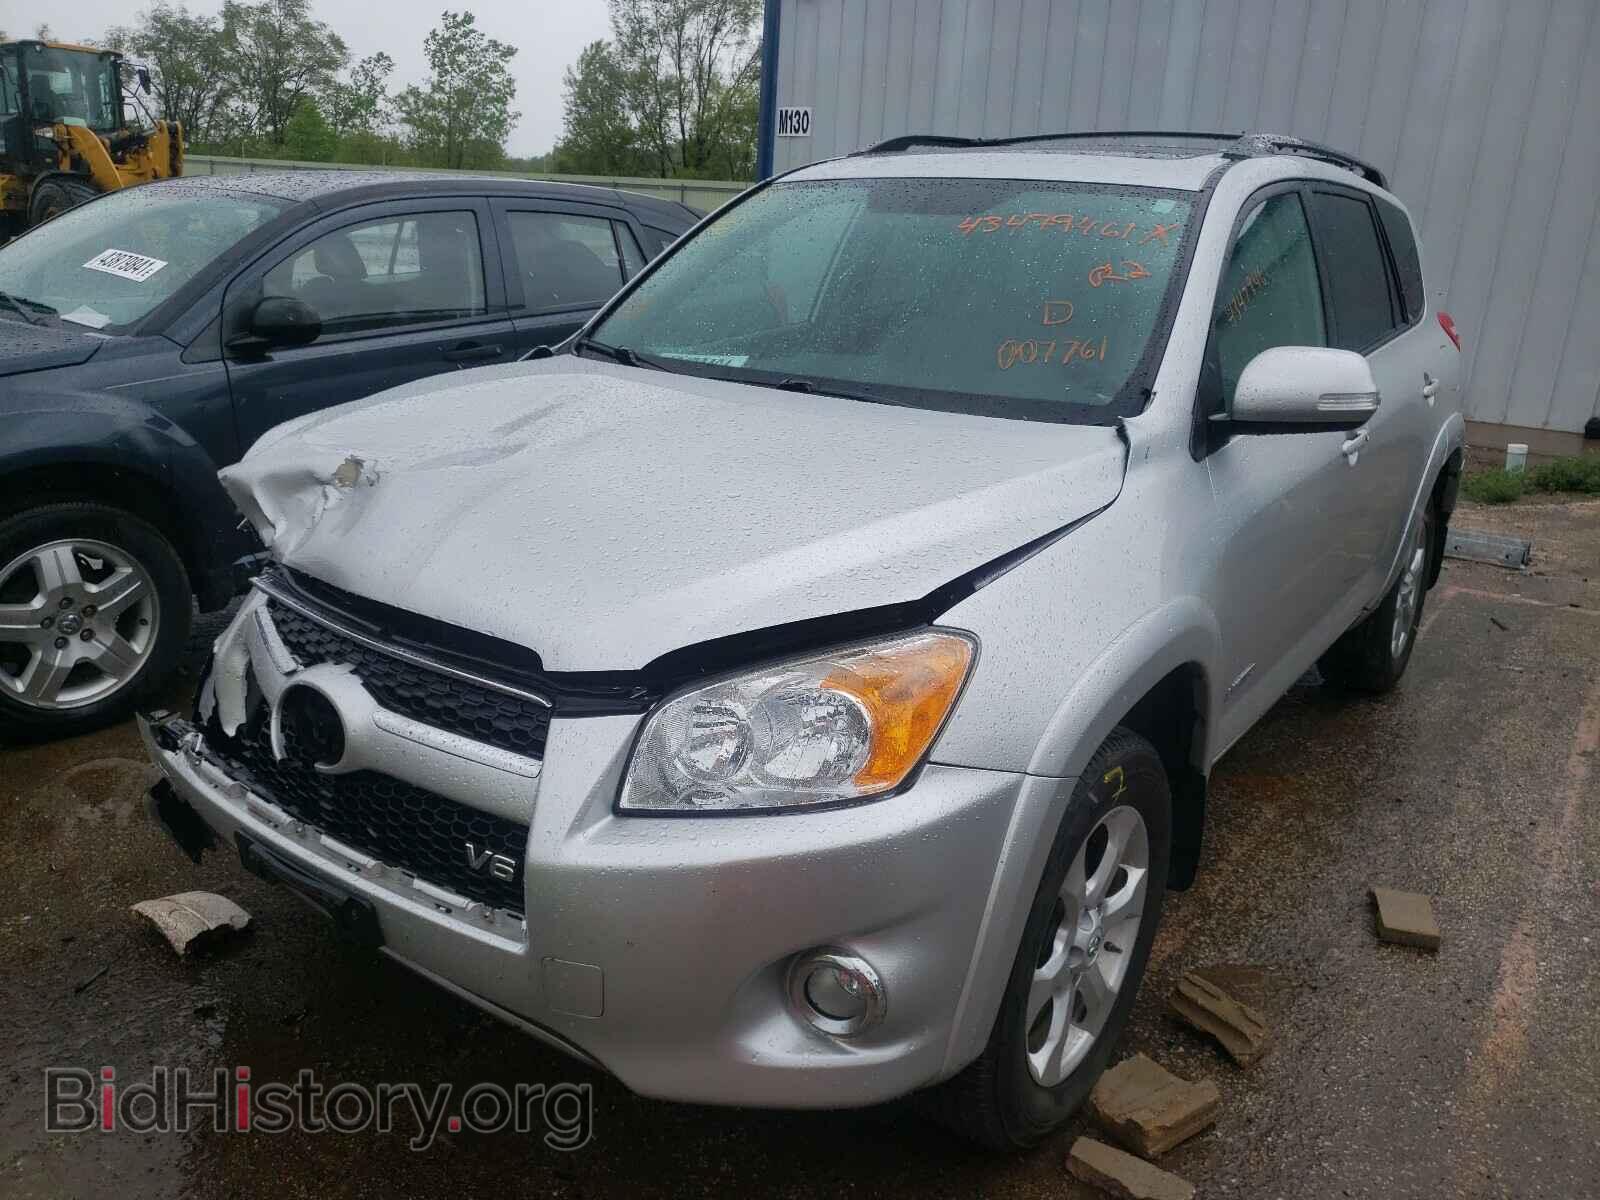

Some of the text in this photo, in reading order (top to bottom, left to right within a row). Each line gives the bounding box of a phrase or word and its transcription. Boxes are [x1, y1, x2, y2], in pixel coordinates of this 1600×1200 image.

[778, 109, 810, 135] M130
[1043, 299, 1074, 326] D
[464, 843, 516, 882] V6
